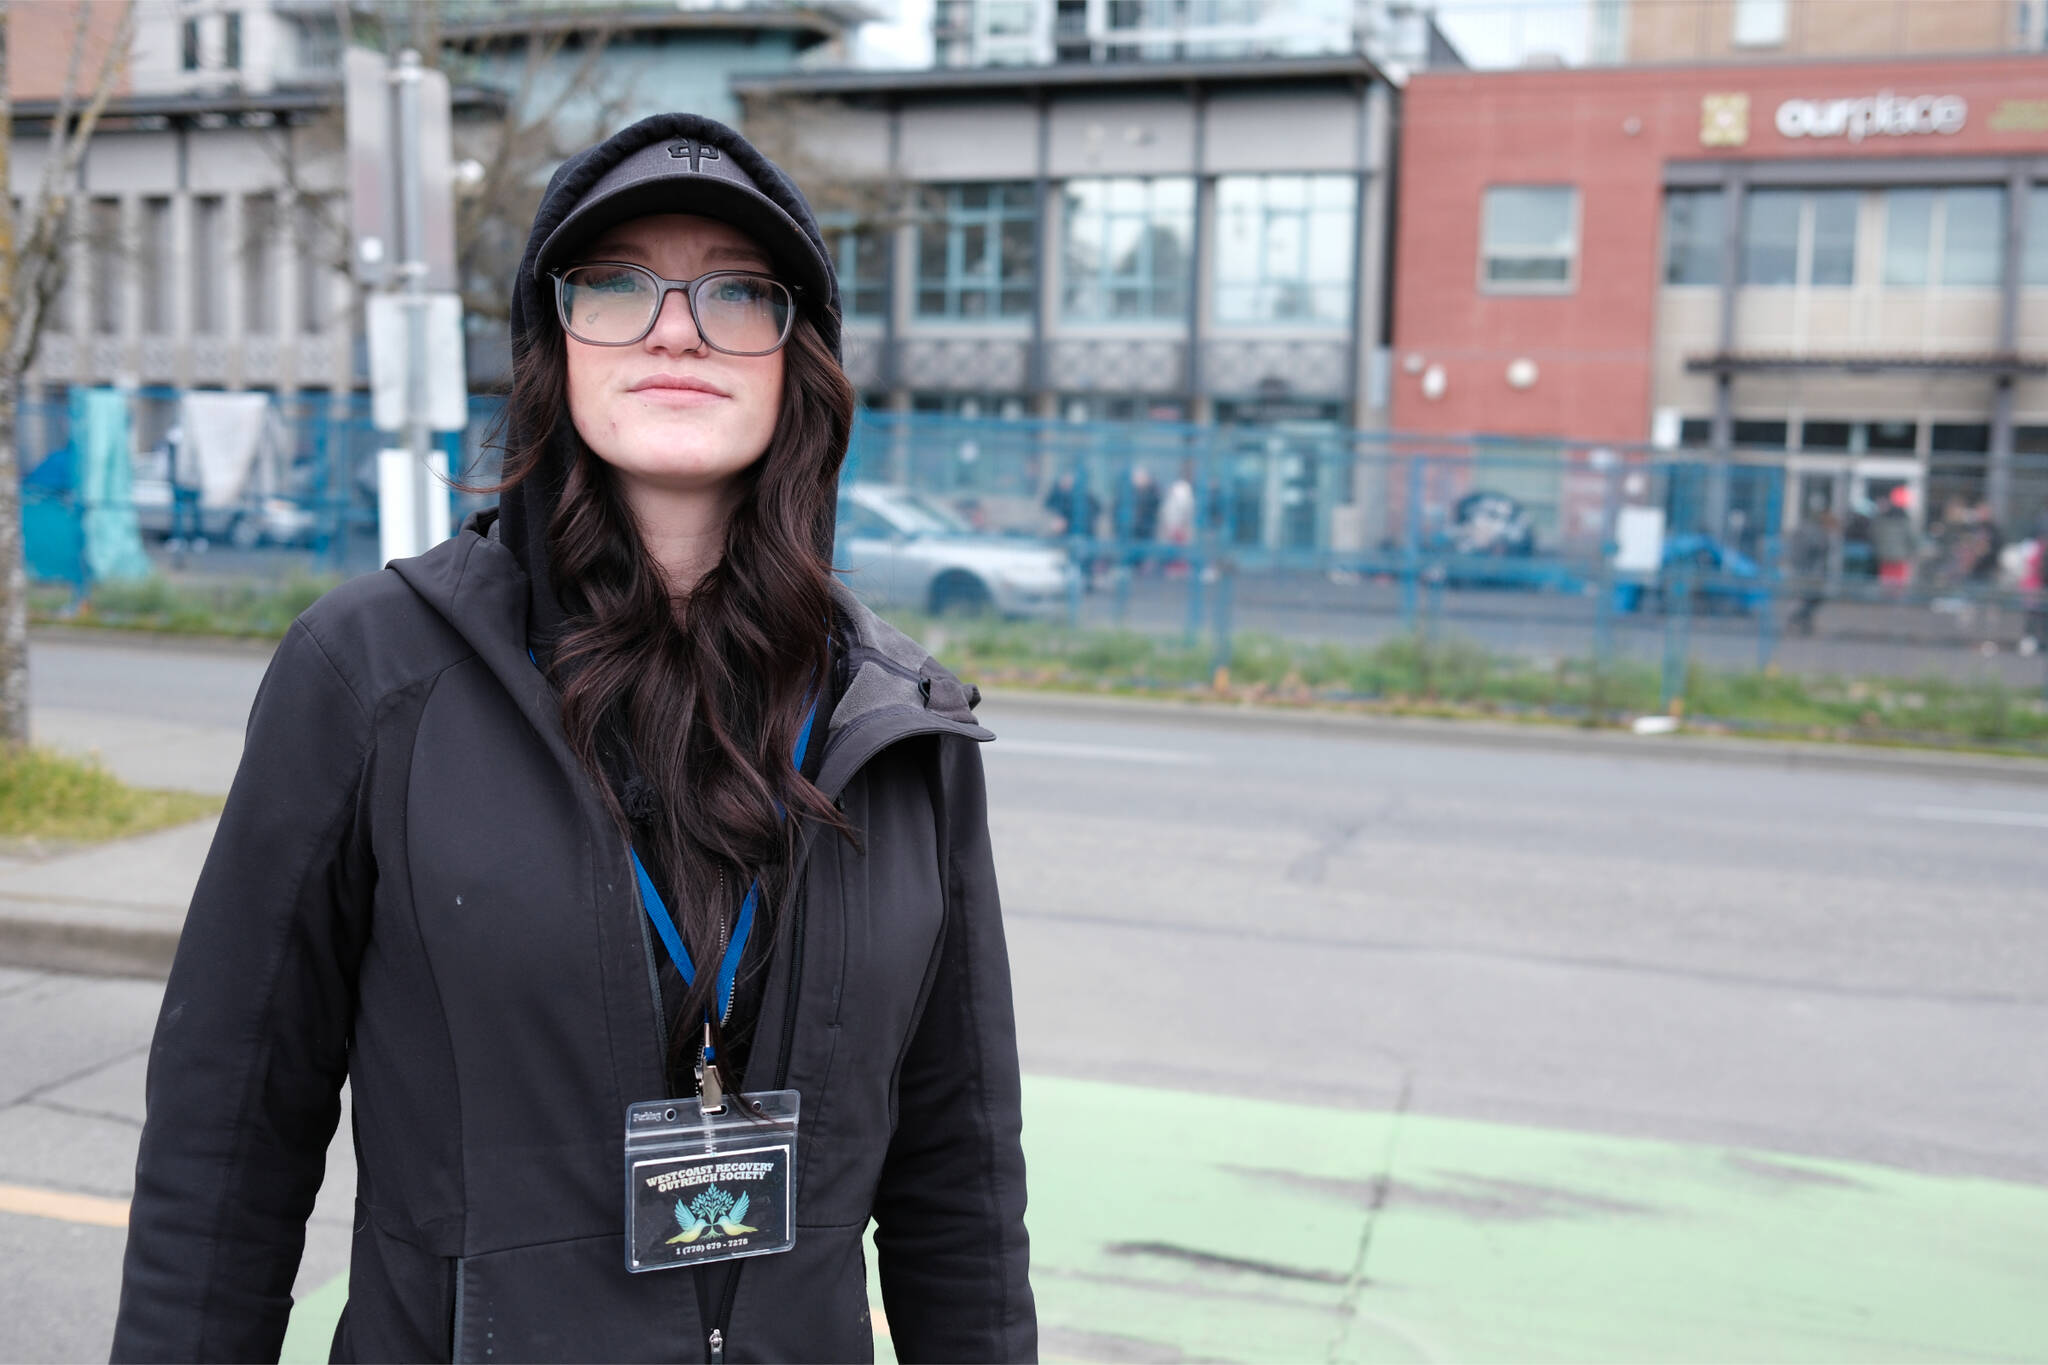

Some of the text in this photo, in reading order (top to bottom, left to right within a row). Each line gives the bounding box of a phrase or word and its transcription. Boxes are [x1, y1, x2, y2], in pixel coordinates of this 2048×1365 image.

[646, 1162, 774, 1187] WESTCOAST RECOVERY
[658, 1171, 766, 1192] OUTREACH SOCIETY
[706, 1242, 722, 1250] 679
